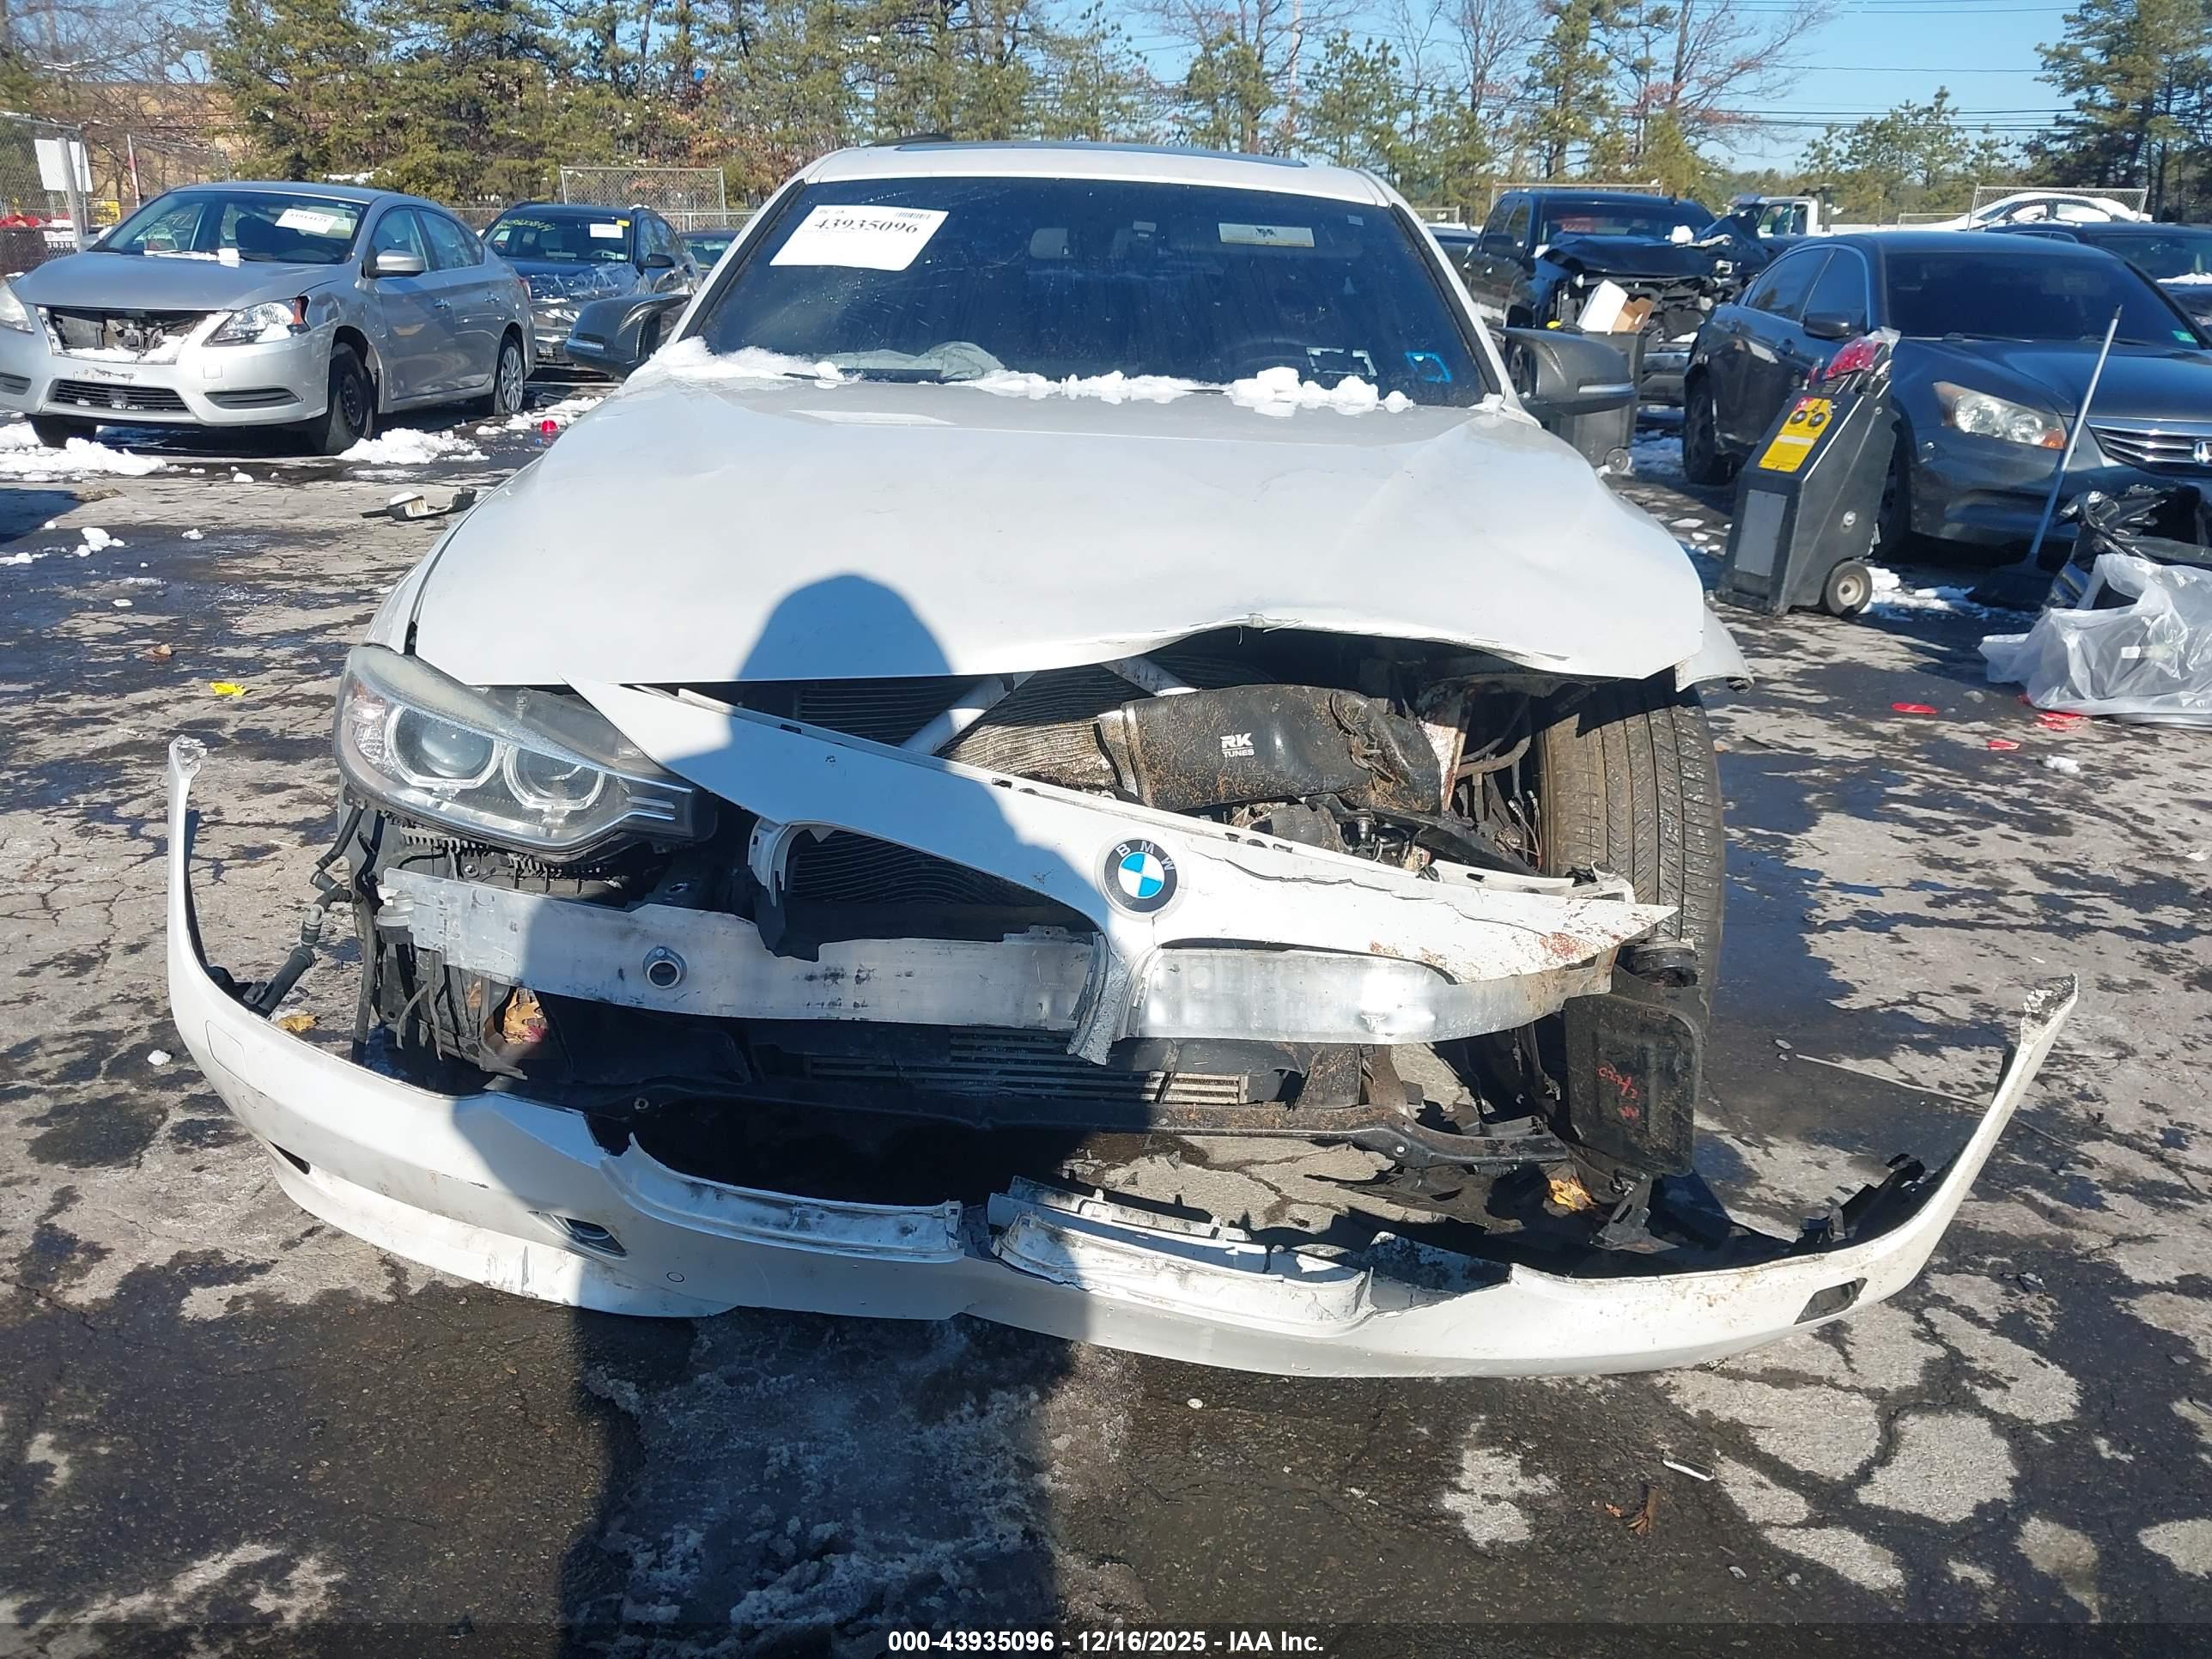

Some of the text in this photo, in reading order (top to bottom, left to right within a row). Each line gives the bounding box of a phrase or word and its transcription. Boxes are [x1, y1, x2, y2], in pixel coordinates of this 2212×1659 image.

[814, 219, 918, 234] 43935096
[1220, 732, 1254, 748] RK
[1223, 748, 1255, 758] TUNES
[1115, 841, 1176, 872] BMW
